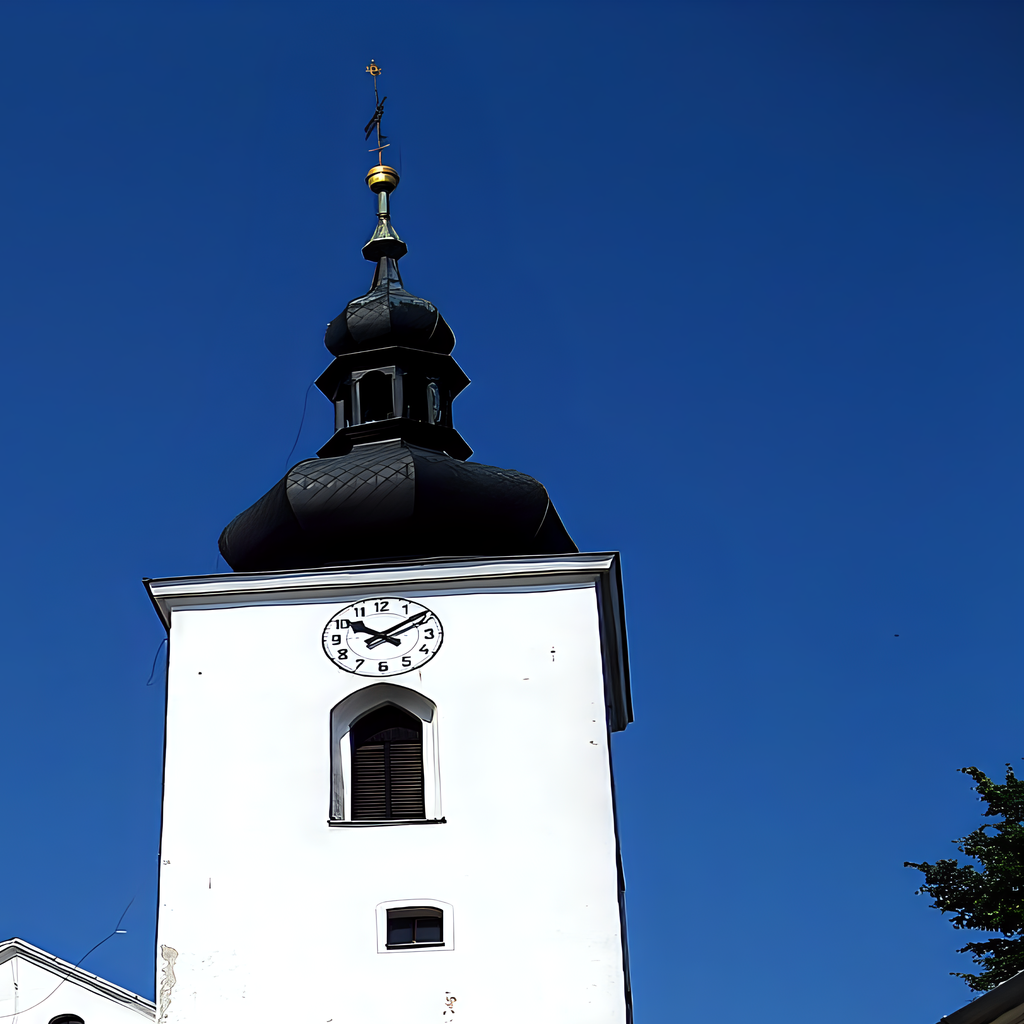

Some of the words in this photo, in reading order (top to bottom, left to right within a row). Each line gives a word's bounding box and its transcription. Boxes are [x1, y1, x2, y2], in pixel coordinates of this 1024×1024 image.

[354, 606, 365, 617] 11
[374, 601, 390, 613] 12
[402, 604, 409, 615] 1
[335, 619, 351, 630] 10
[424, 628, 435, 639] 3
[331, 634, 341, 645] 9
[337, 648, 348, 660] 8
[418, 643, 429, 654] 4
[355, 658, 365, 672] 7
[378, 661, 389, 672] 6
[401, 656, 412, 667] 5
